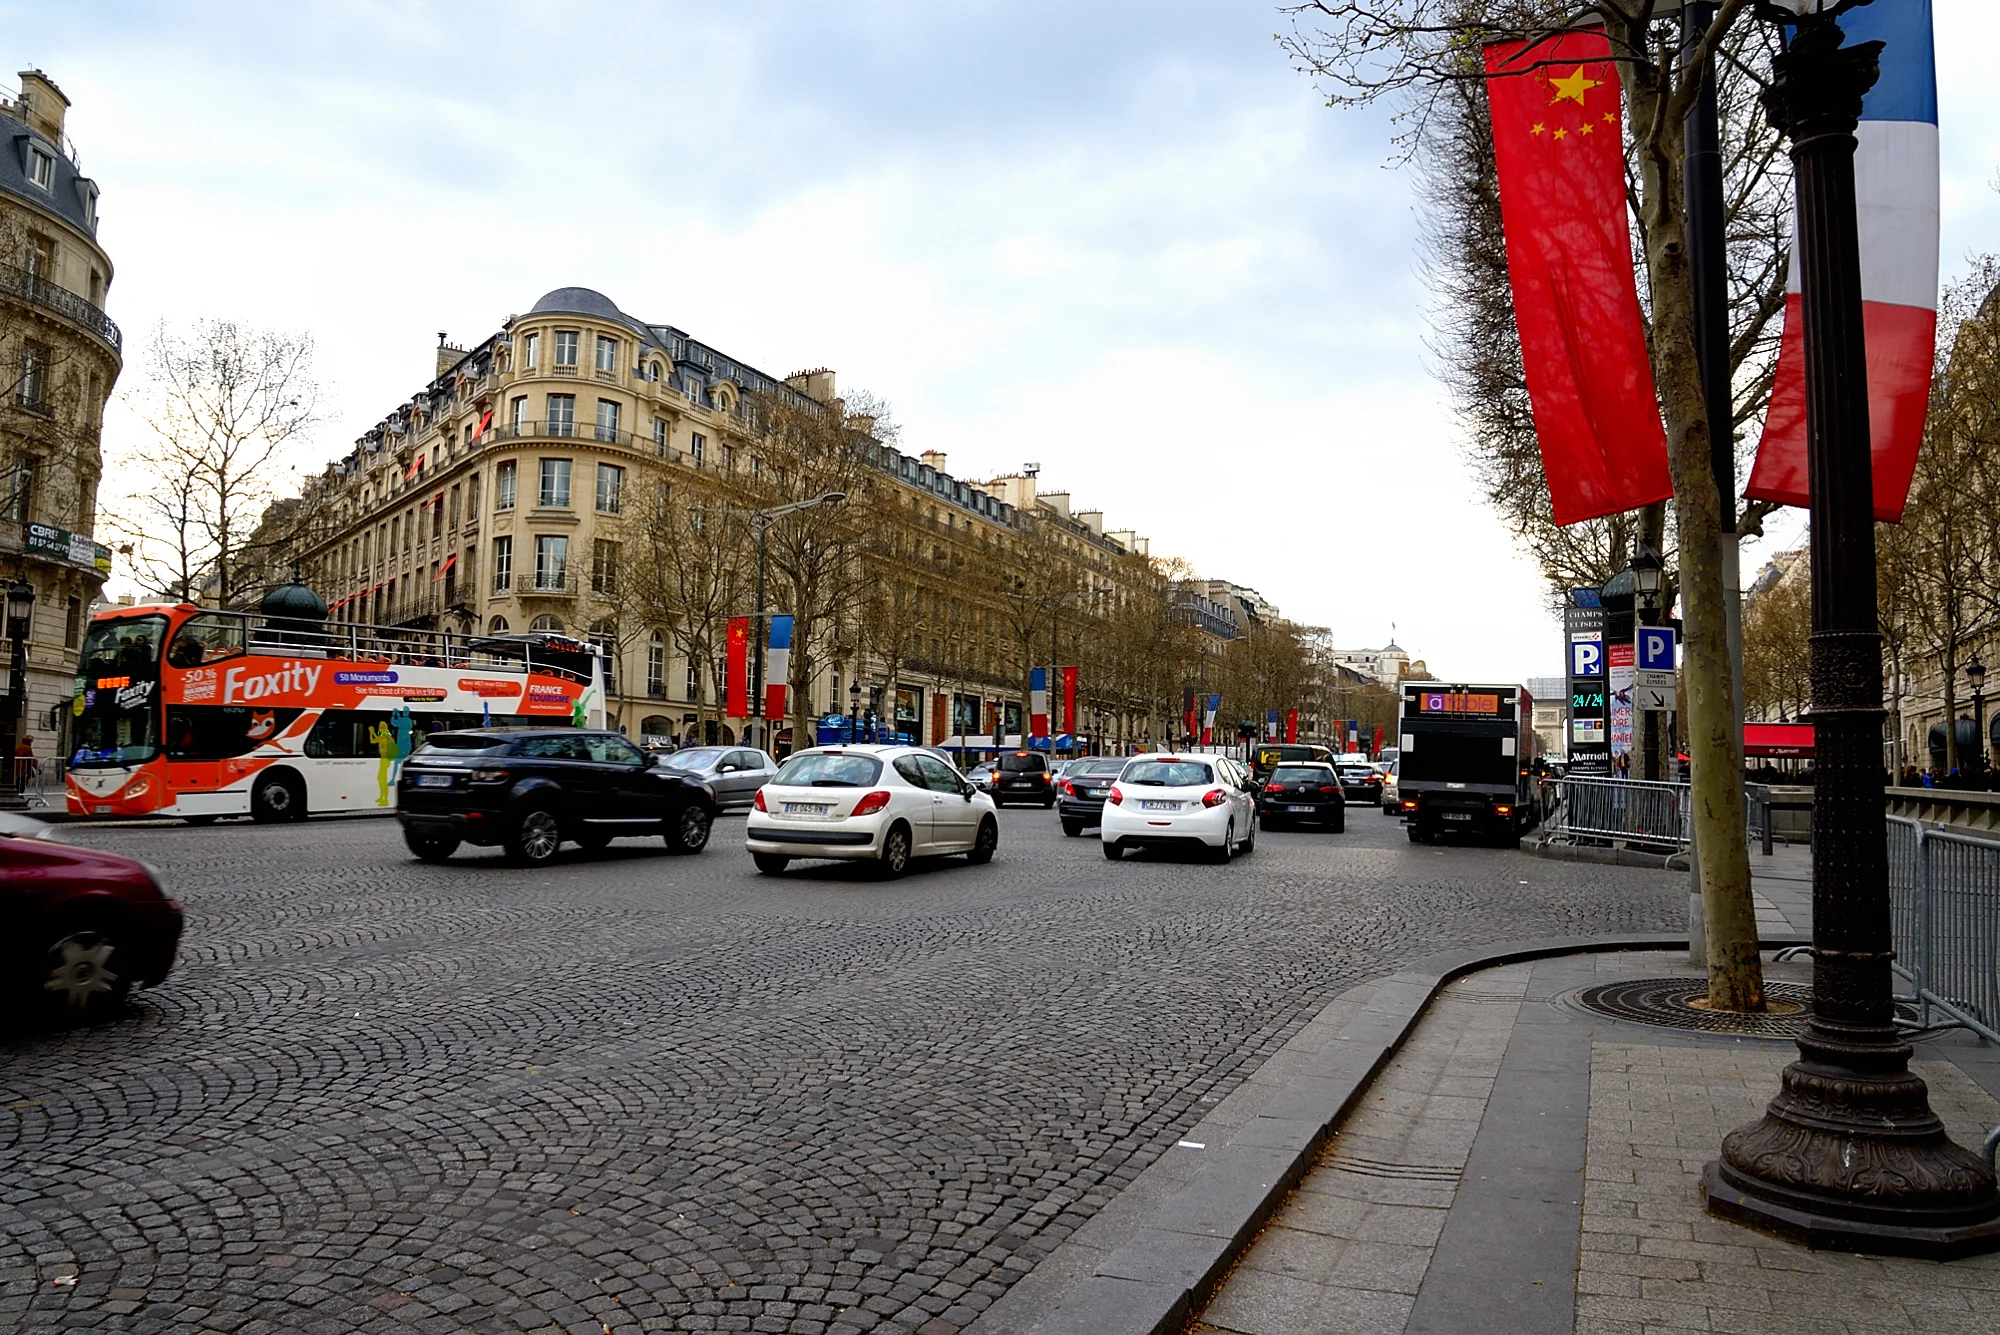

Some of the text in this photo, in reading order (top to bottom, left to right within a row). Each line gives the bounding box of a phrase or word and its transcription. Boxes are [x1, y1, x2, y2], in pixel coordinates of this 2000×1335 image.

[1648, 636, 1665, 663] P
[1574, 644, 1599, 674] P
[181, 668, 217, 683] -50 %
[223, 661, 322, 704] Foxity
[340, 673, 390, 682] 50 Monuments
[114, 680, 155, 703] Foxity
[355, 686, 367, 694] See
[368, 686, 379, 694] the
[379, 687, 393, 695] Best
[393, 687, 400, 695] of
[529, 684, 563, 695] FRANCE
[529, 693, 570, 703] TOURISME
[1573, 693, 1604, 707] 24/24
[1570, 752, 1608, 762] Marriott
